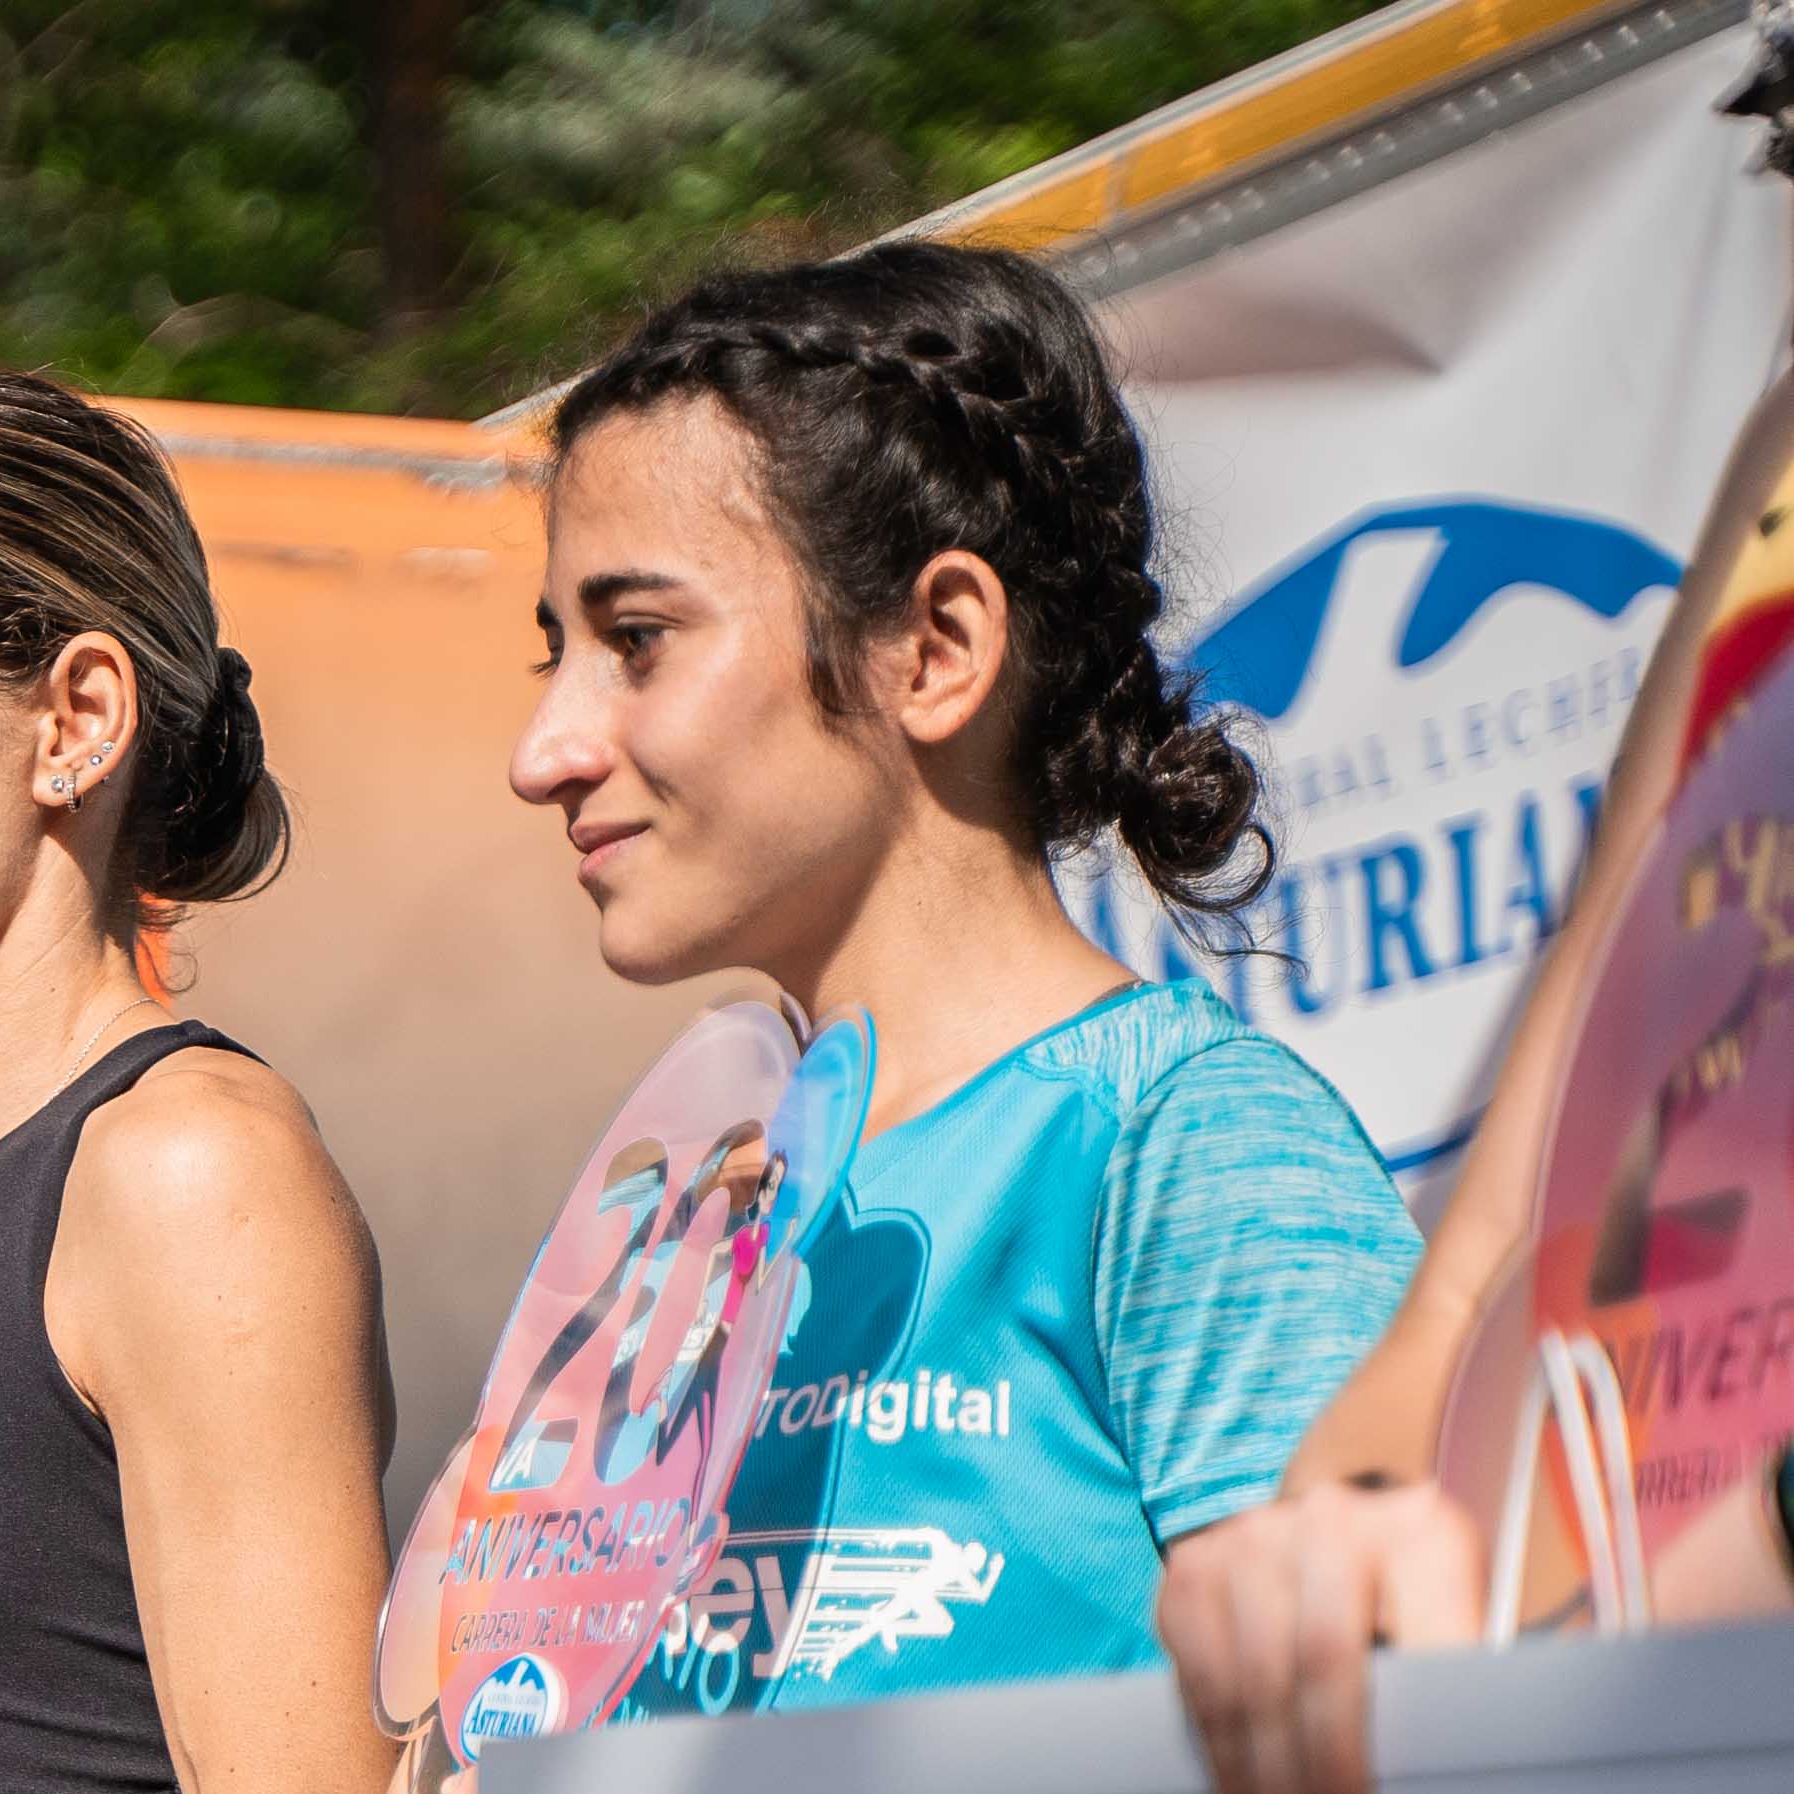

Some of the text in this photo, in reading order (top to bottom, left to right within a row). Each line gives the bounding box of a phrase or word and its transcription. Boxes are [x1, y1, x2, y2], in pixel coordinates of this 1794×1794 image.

[1419, 647, 1643, 782] LECHER
[438, 1497, 693, 1585] ANIVERSARIO
[451, 1600, 645, 1655] CARRERA DE LA MUJER
